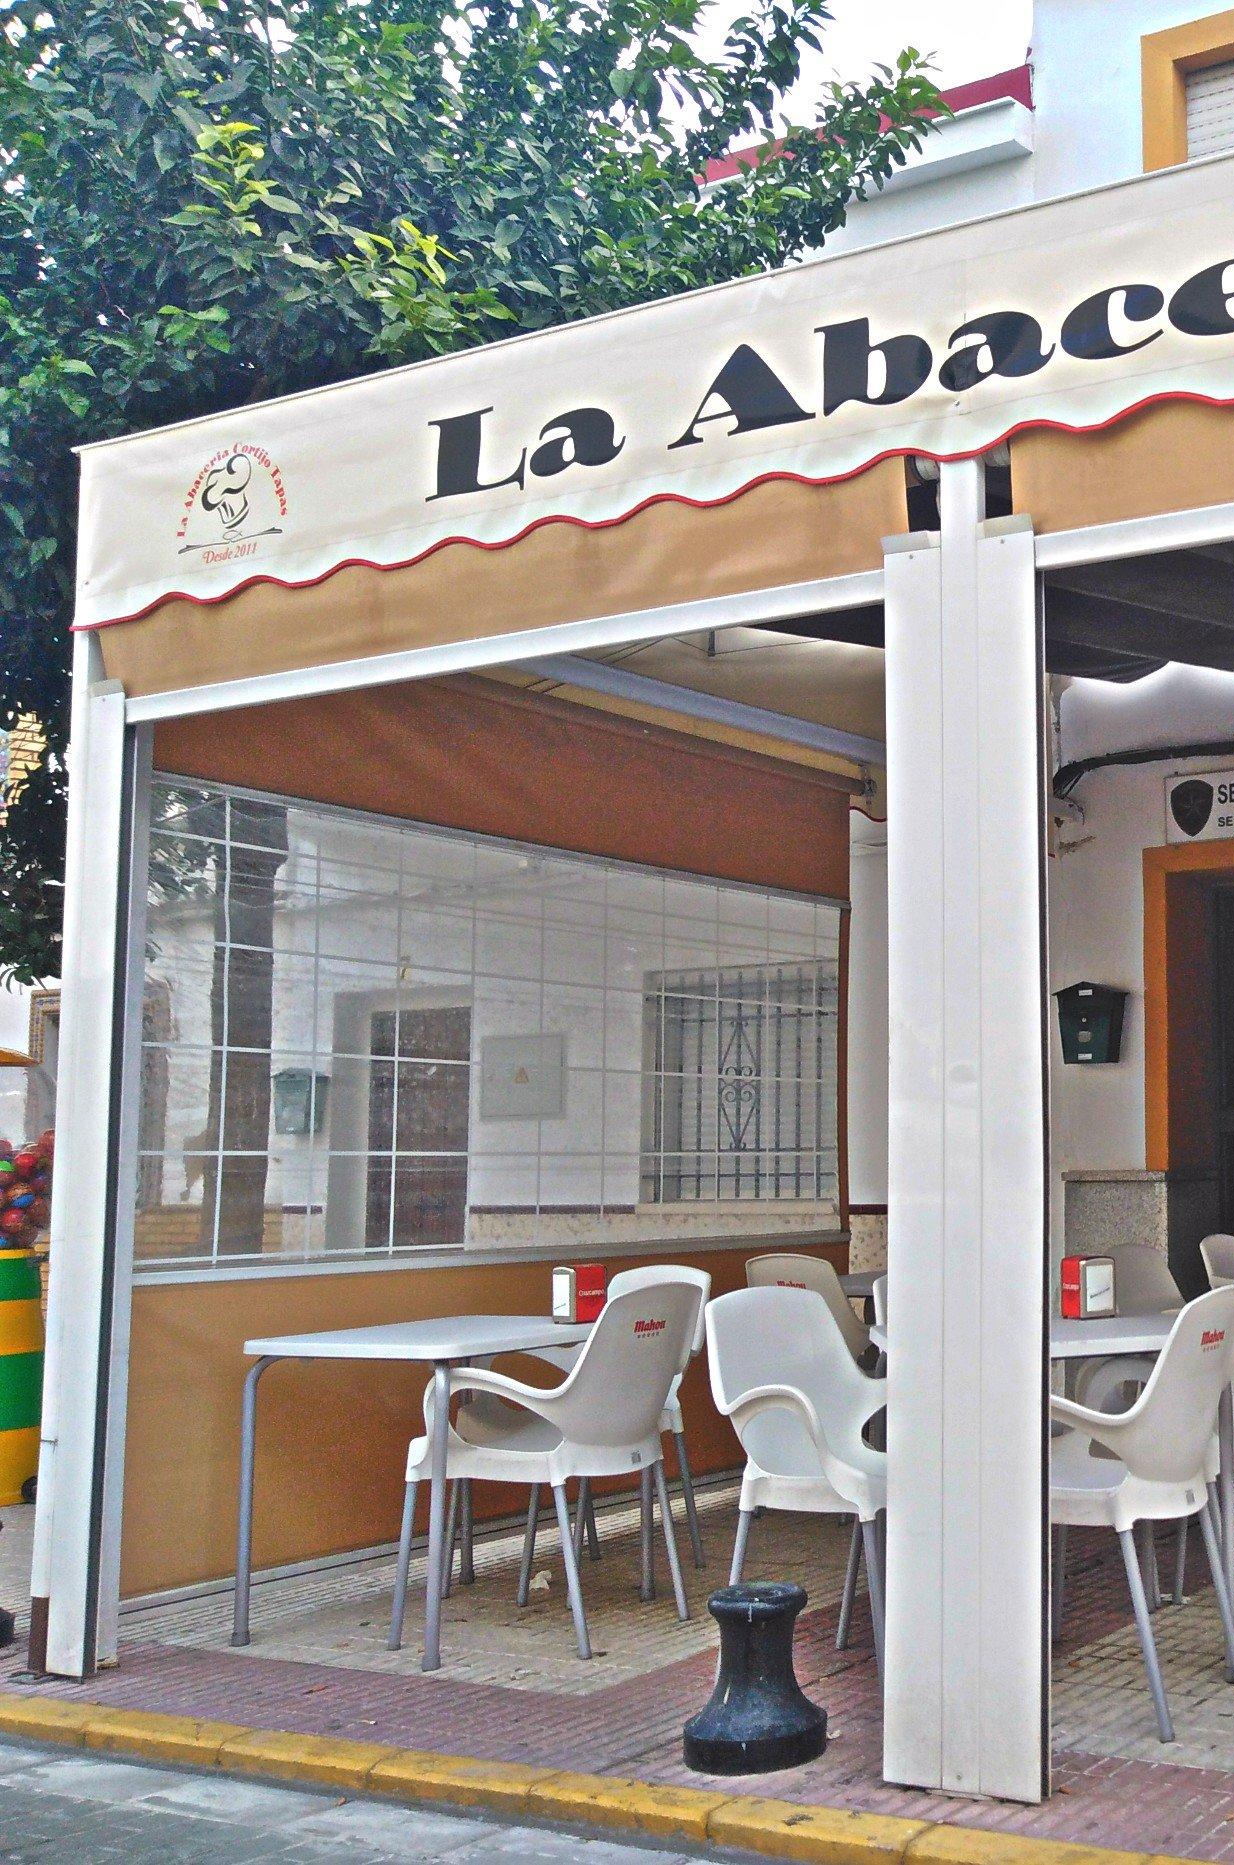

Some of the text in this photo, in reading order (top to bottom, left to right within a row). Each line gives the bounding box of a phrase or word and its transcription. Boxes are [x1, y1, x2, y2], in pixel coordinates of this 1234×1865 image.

[232, 441, 271, 468] Cortijo
[425, 406, 626, 502] La
[203, 542, 258, 564] Desde 2011
